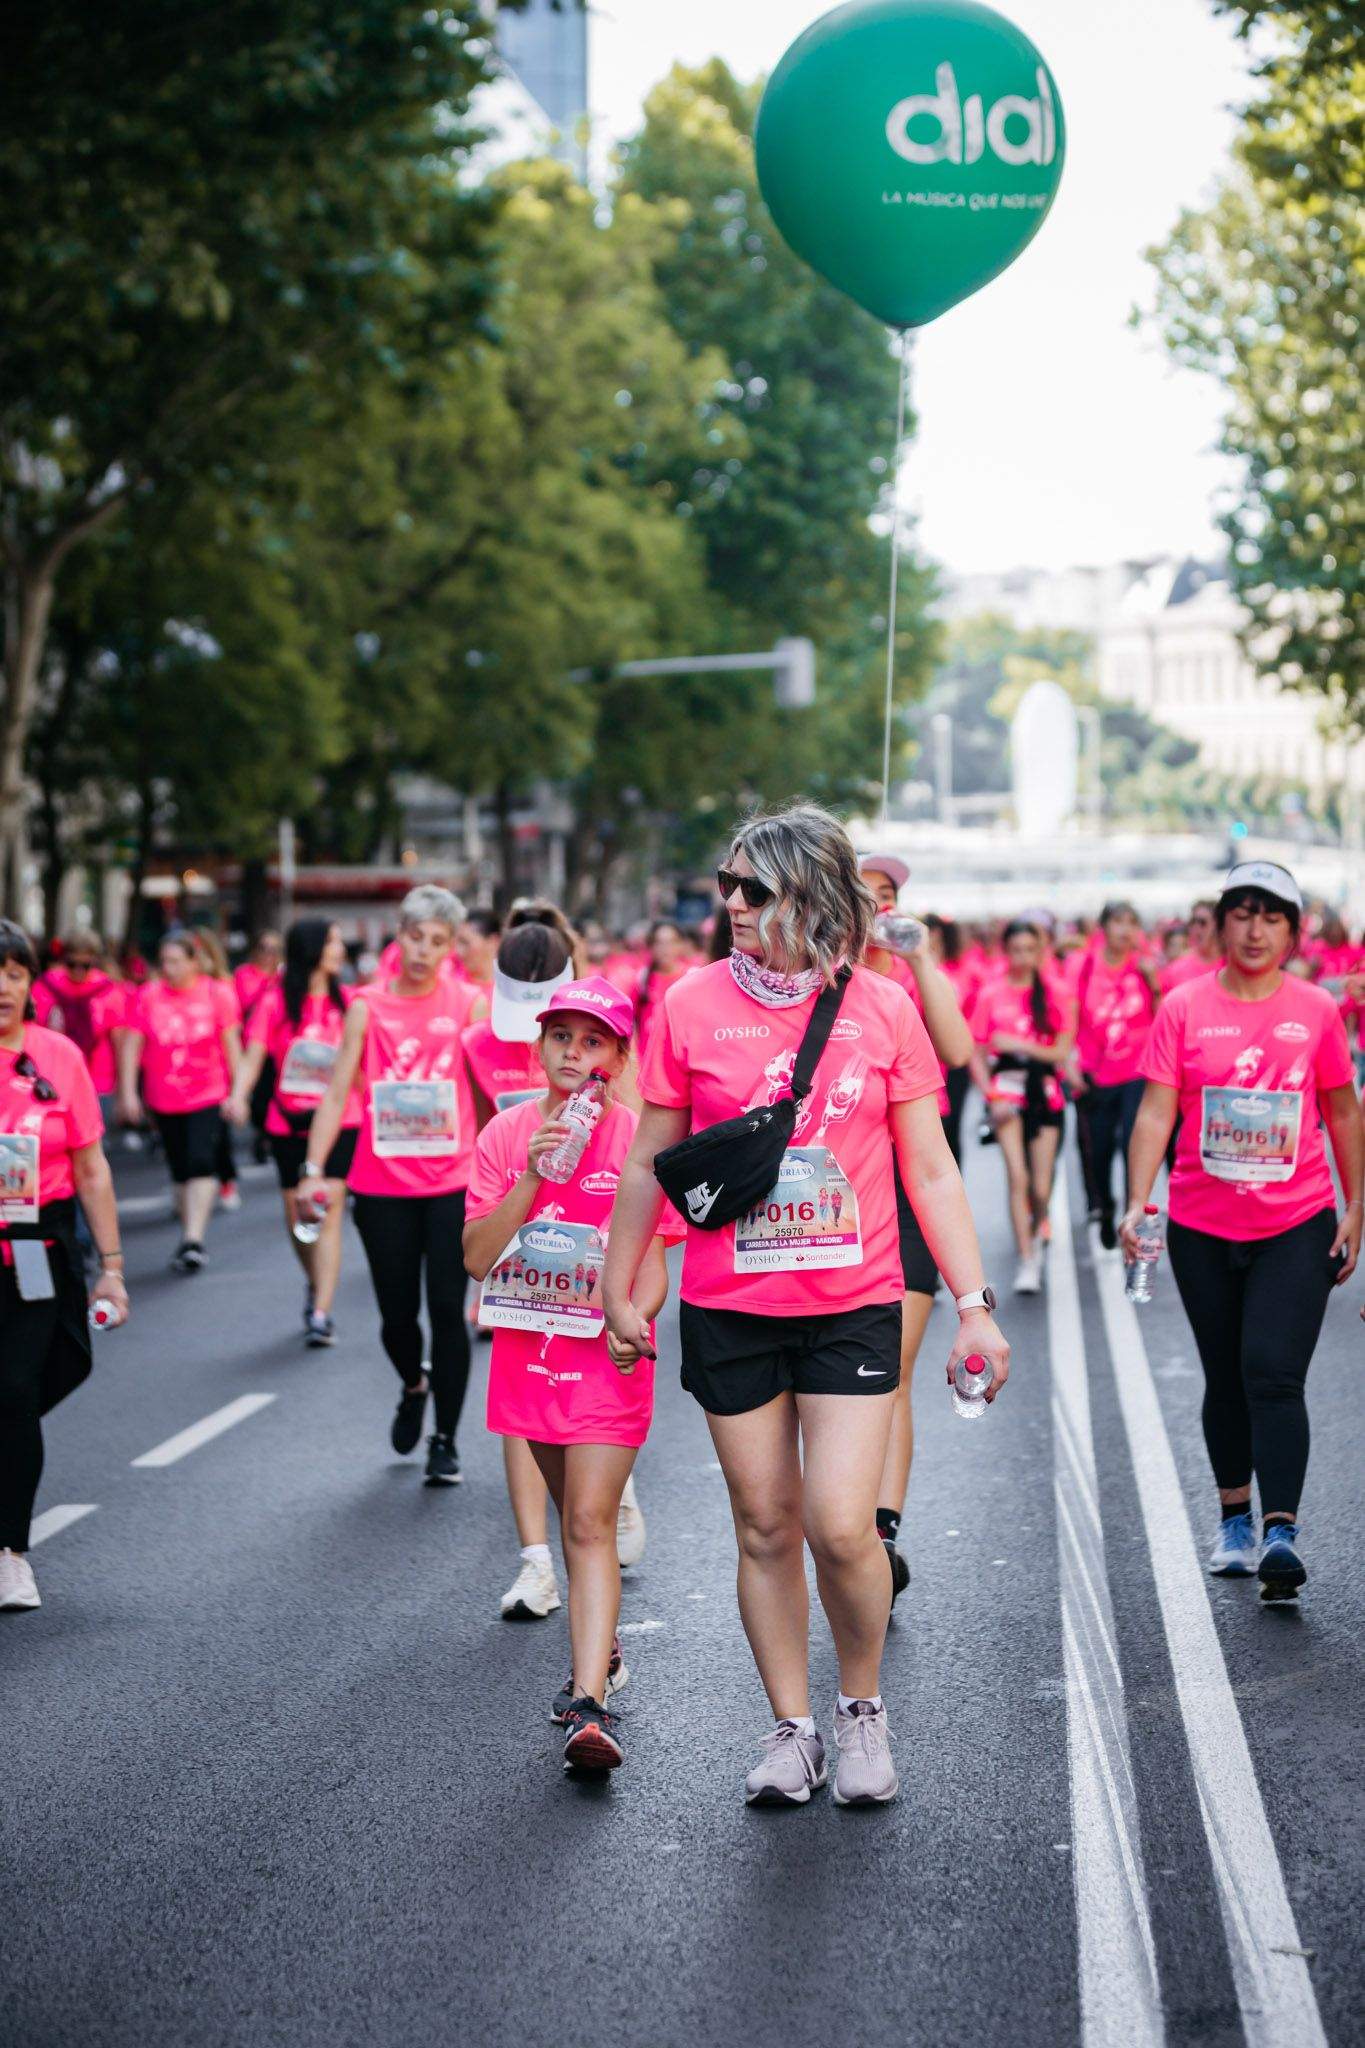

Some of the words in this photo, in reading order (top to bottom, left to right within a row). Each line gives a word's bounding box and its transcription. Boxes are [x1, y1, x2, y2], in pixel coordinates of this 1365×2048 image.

[885, 60, 1056, 166] dial
[882, 191, 902, 204] LA
[566, 989, 614, 1009] DRUNI
[714, 1025, 771, 1041] OYSHO
[572, 1101, 594, 1114] ZERO
[1232, 1129, 1268, 1145] 016
[780, 1167, 812, 1177] URIANA
[583, 1180, 618, 1189] ASTURIAN
[684, 1181, 714, 1211] NIKE
[767, 1201, 815, 1223] 016
[775, 1227, 804, 1237] 25970
[526, 1236, 574, 1250] ASTURIANA
[745, 1240, 770, 1249] CARRERA
[770, 1239, 779, 1247] DE
[789, 1238, 811, 1246] MUJER
[816, 1236, 843, 1244] MADRID
[745, 1254, 781, 1265] OYSHO
[806, 1252, 846, 1262] Santander
[525, 1268, 571, 1291] 016
[530, 1291, 557, 1302] 25971
[495, 1298, 523, 1307] CARRERA
[542, 1303, 563, 1312] MUJER
[567, 1306, 592, 1316] MADRID
[493, 1311, 532, 1323] OYSHO
[555, 1321, 591, 1331] Santander
